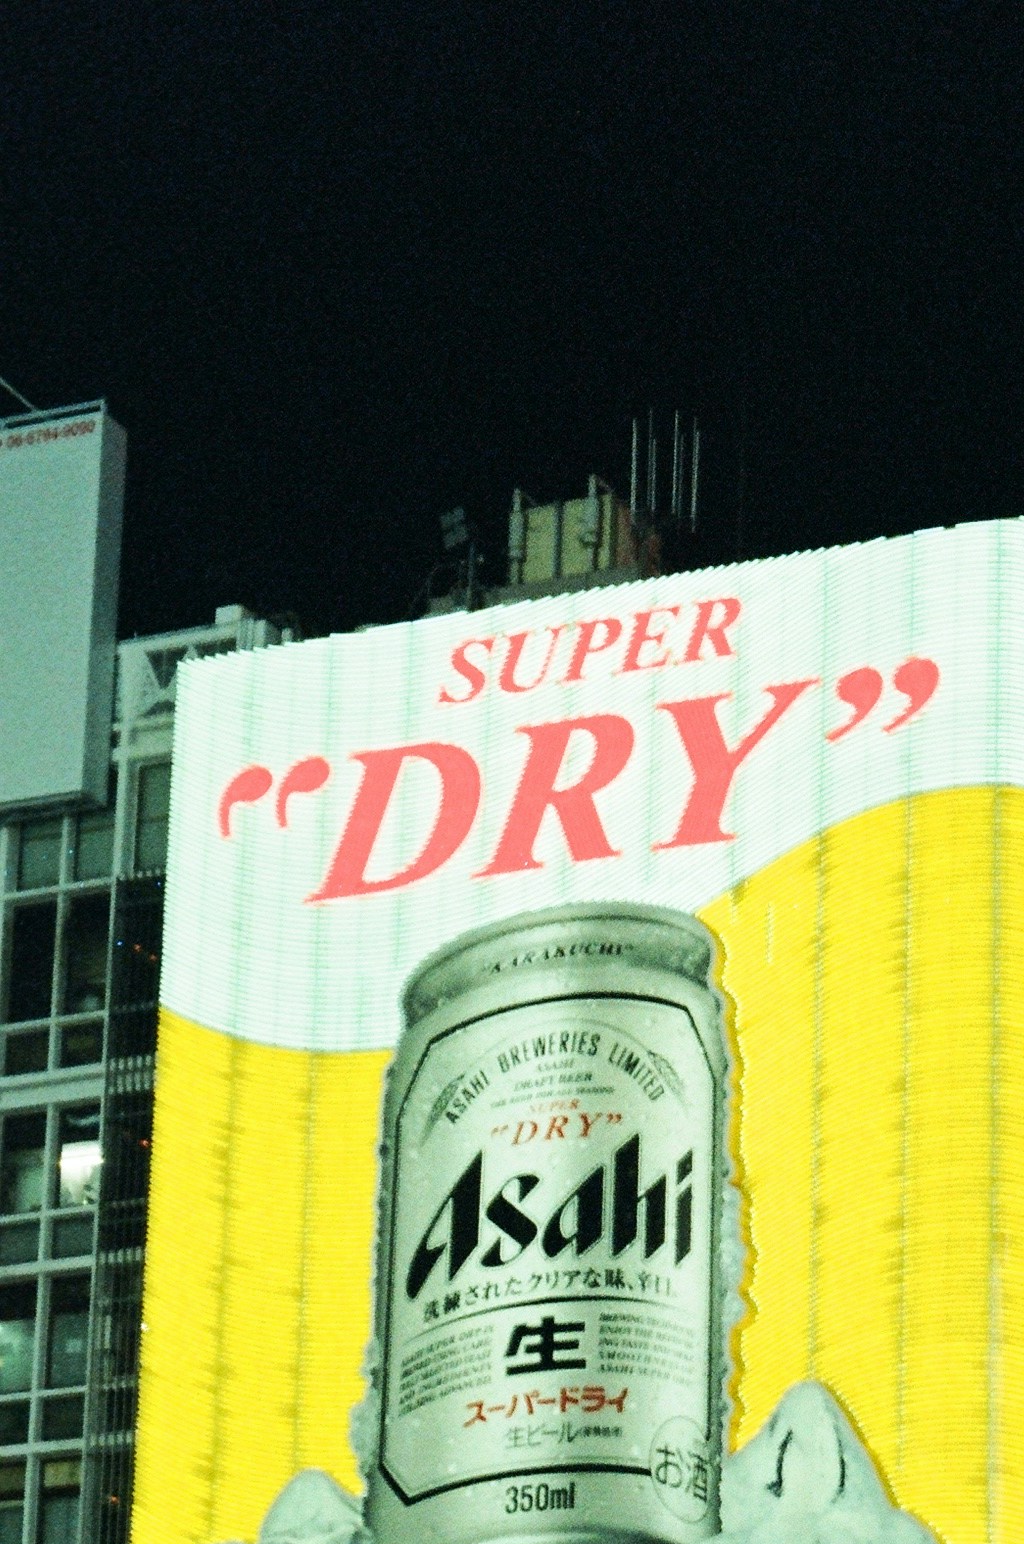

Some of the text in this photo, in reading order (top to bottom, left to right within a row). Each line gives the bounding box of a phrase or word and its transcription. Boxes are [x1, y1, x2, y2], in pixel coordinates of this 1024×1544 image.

[437, 597, 743, 704] SUPER
[443, 1030, 665, 1124] ASAHI BREWERIES LIMITED
[405, 1132, 694, 1300] Asahi
[502, 1315, 587, 1377] 生
[463, 1386, 629, 1429] スーパードライ
[504, 1481, 576, 1514] 350ml
